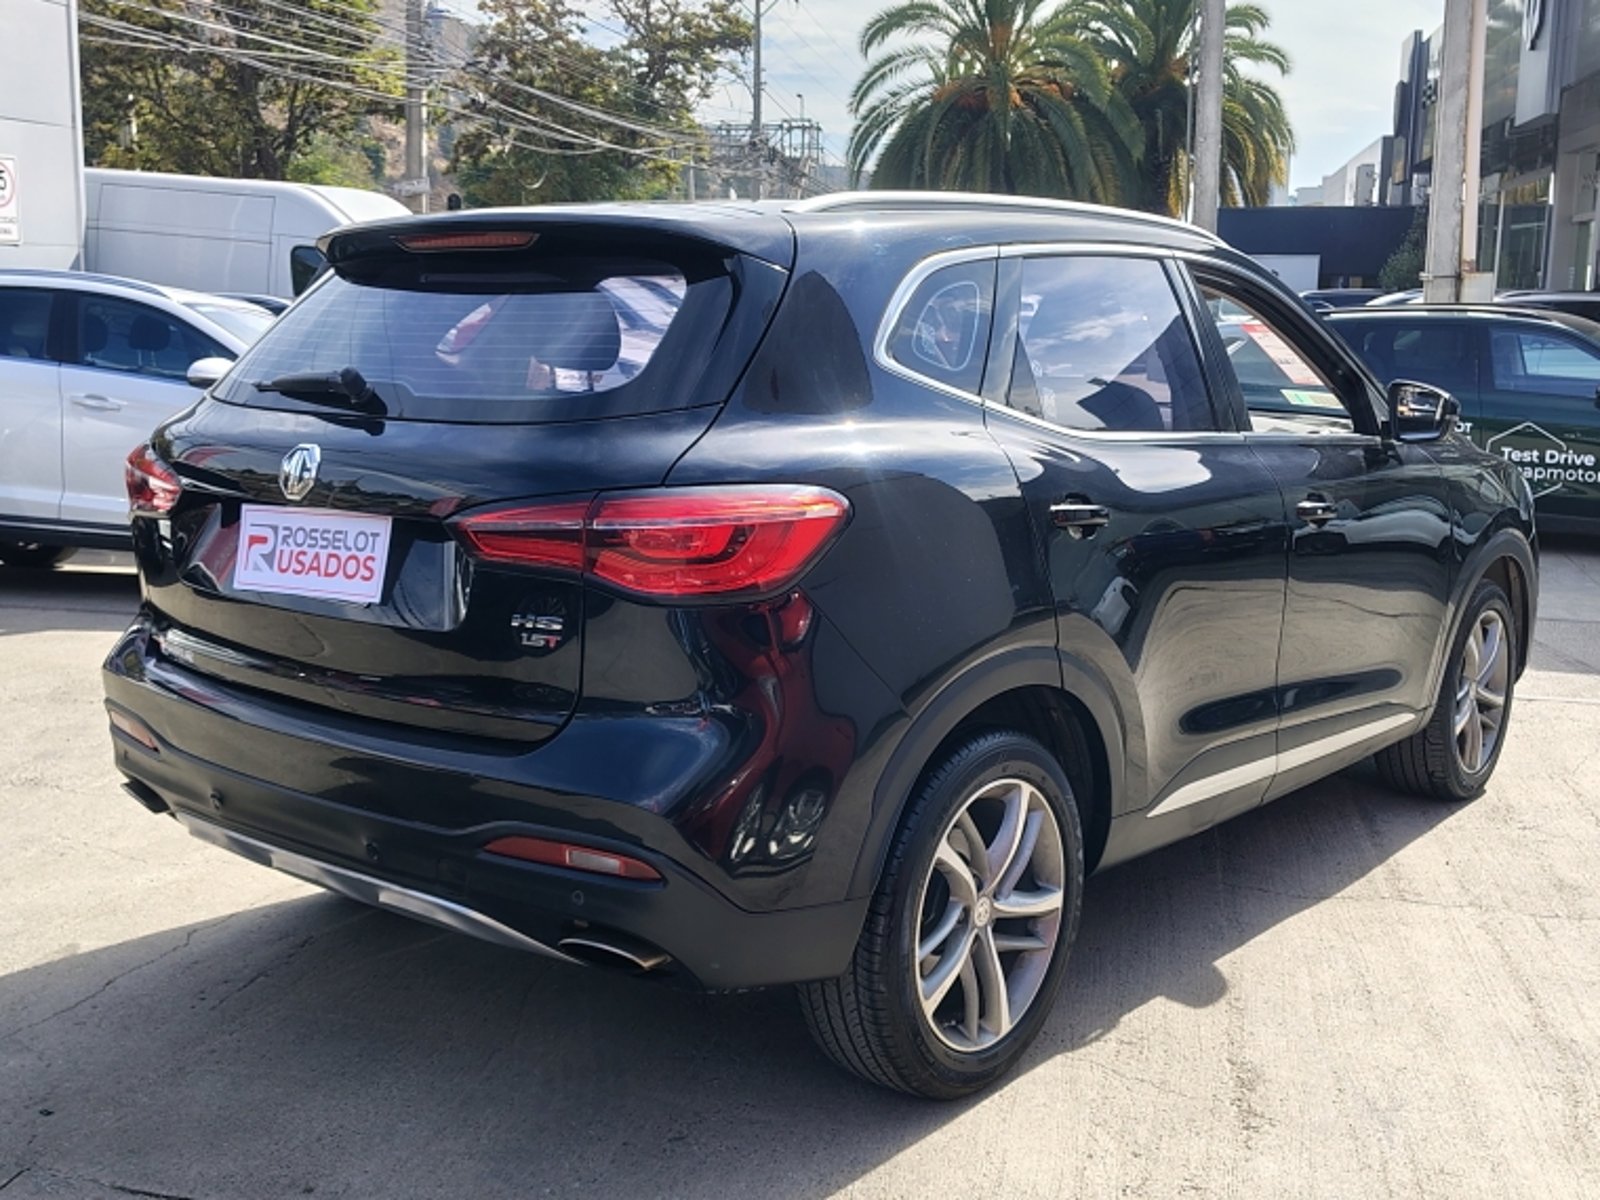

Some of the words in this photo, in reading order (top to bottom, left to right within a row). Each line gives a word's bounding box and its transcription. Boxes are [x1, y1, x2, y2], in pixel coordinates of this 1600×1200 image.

[1501, 446, 1540, 463] Test
[1544, 449, 1596, 467] Drive
[1517, 465, 1600, 483] apmoto
[281, 526, 381, 553] ROSSELOT
[277, 549, 376, 582] USADOS
[510, 614, 563, 630] HS
